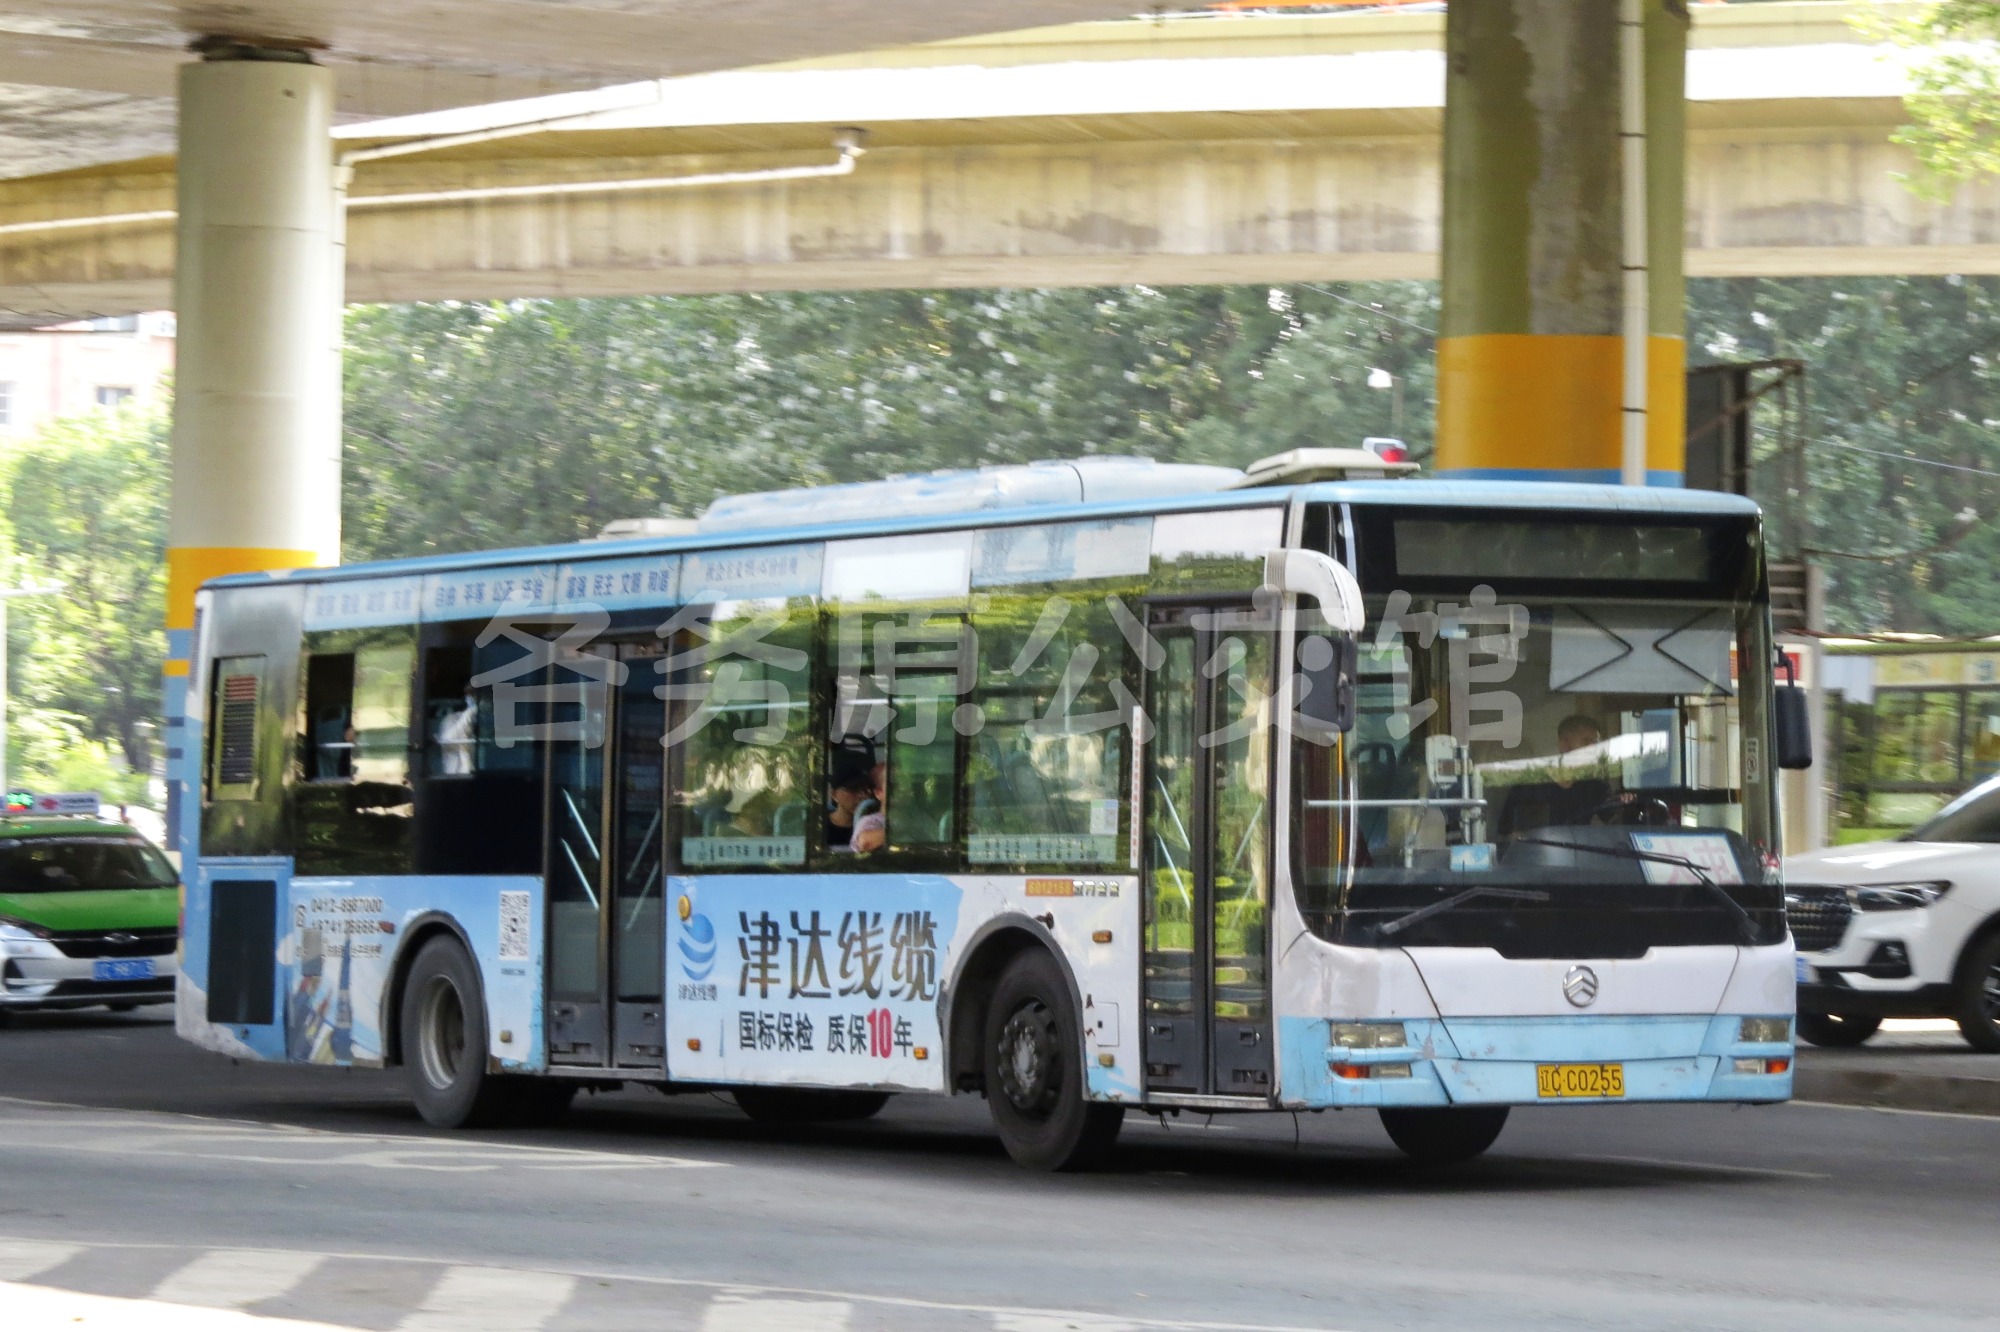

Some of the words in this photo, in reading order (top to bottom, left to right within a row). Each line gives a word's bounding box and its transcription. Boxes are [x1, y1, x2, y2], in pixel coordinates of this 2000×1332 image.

[737, 910, 938, 1001] 津达线缆
[678, 984, 718, 1001] 津达线缆
[739, 1010, 814, 1053] 国标保检
[827, 1008, 913, 1058] 质保10年
